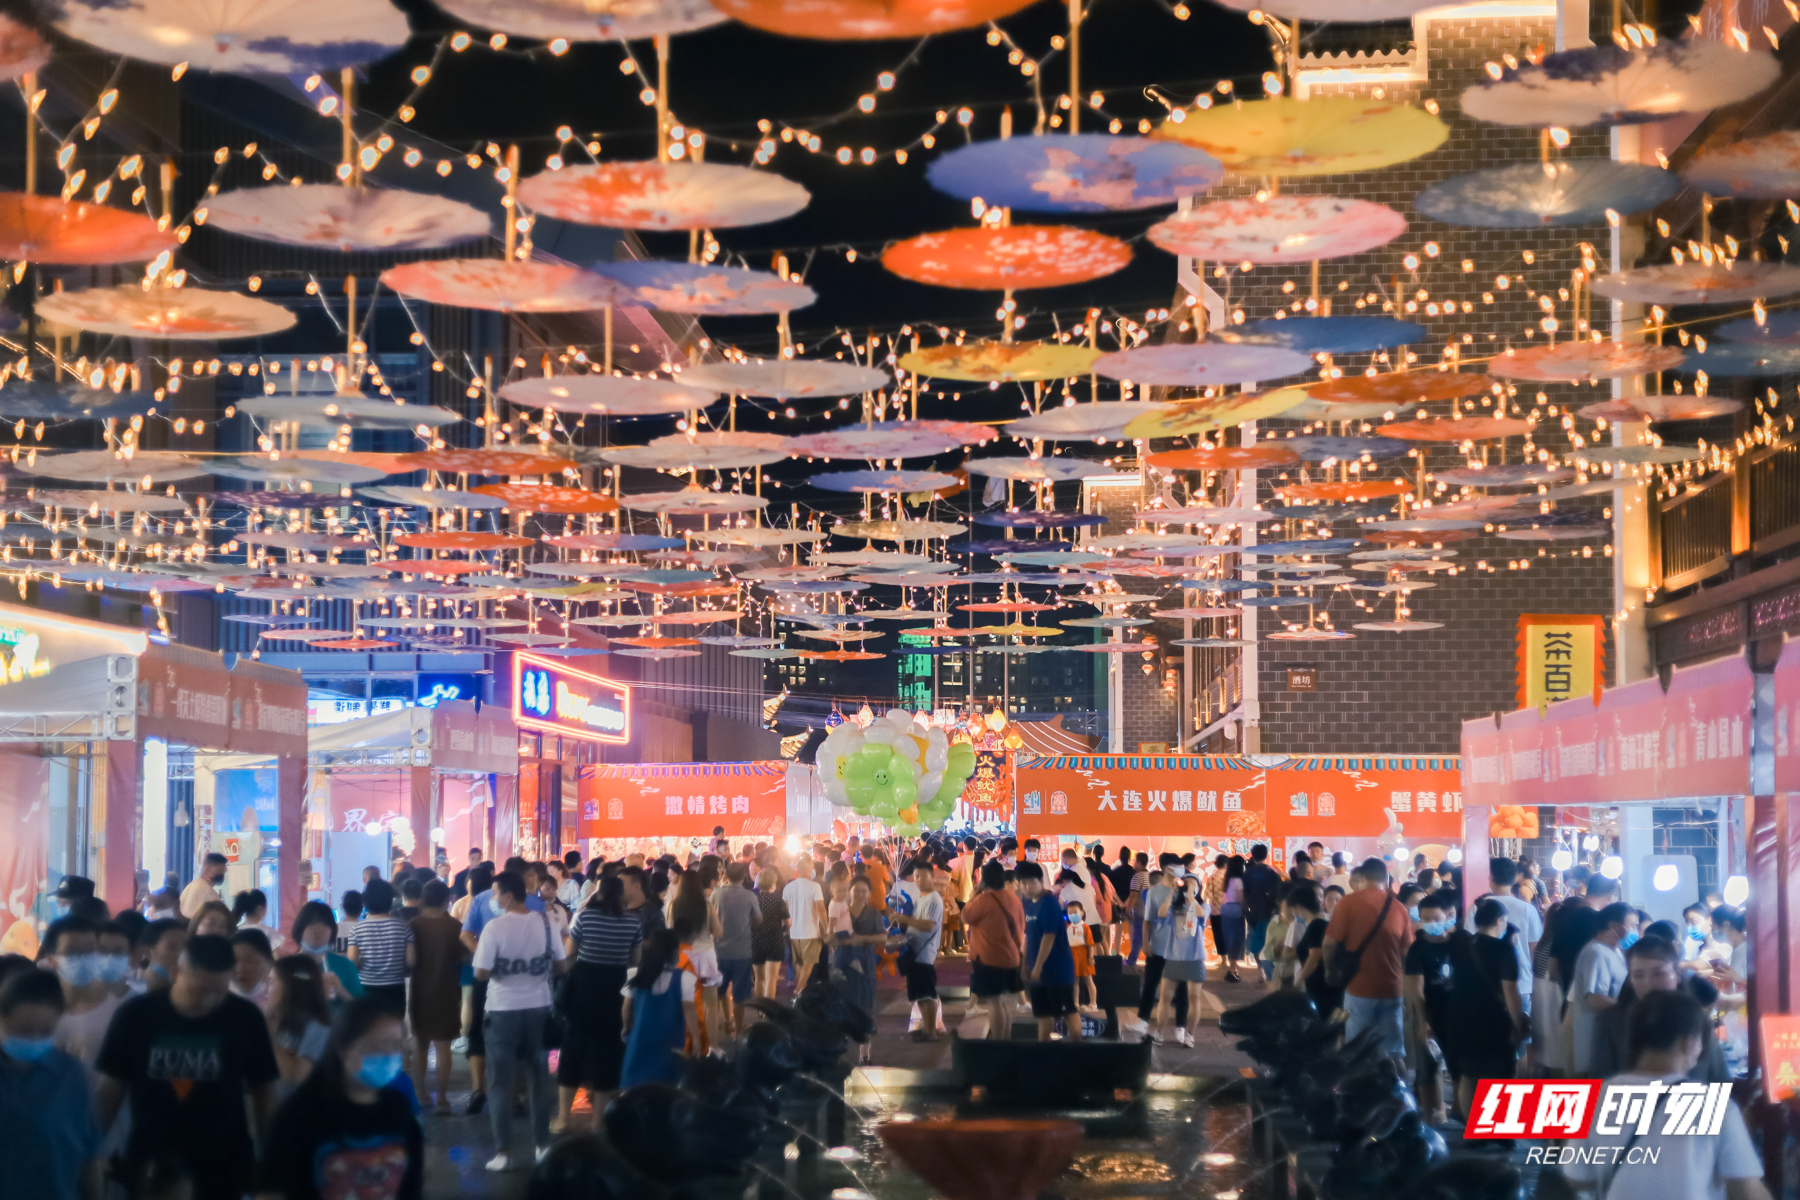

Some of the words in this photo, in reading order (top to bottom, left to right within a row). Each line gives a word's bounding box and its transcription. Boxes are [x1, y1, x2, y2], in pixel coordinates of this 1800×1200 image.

[1292, 675, 1311, 685] 酒坊
[1544, 632, 1573, 706] 茶百
[977, 755, 996, 803] 火爆鱿鱼
[665, 795, 750, 815] 激情烤肉
[1097, 790, 1242, 812] 大连火爆鱿鱼
[149, 1047, 219, 1070] PUMA
